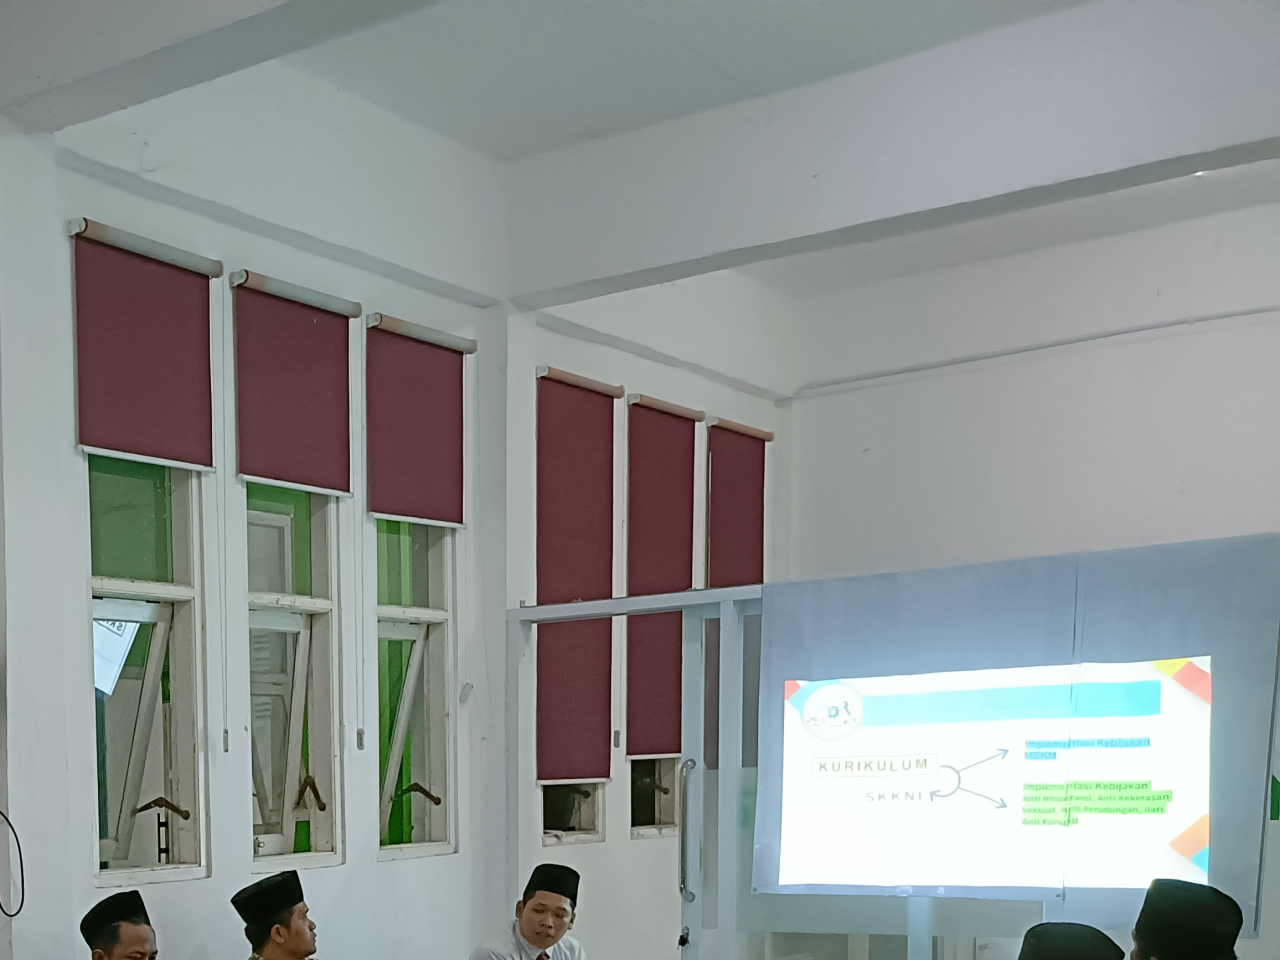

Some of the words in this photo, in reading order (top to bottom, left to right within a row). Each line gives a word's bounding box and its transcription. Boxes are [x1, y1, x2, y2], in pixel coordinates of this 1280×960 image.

[1026, 739, 1094, 749] Implementasi
[1097, 738, 1150, 748] Kebijakan
[819, 759, 927, 772] KURIKULUM
[1023, 783, 1092, 791] Implementasi
[1095, 782, 1148, 791] Kebijakan
[866, 791, 921, 802] SKKNI
